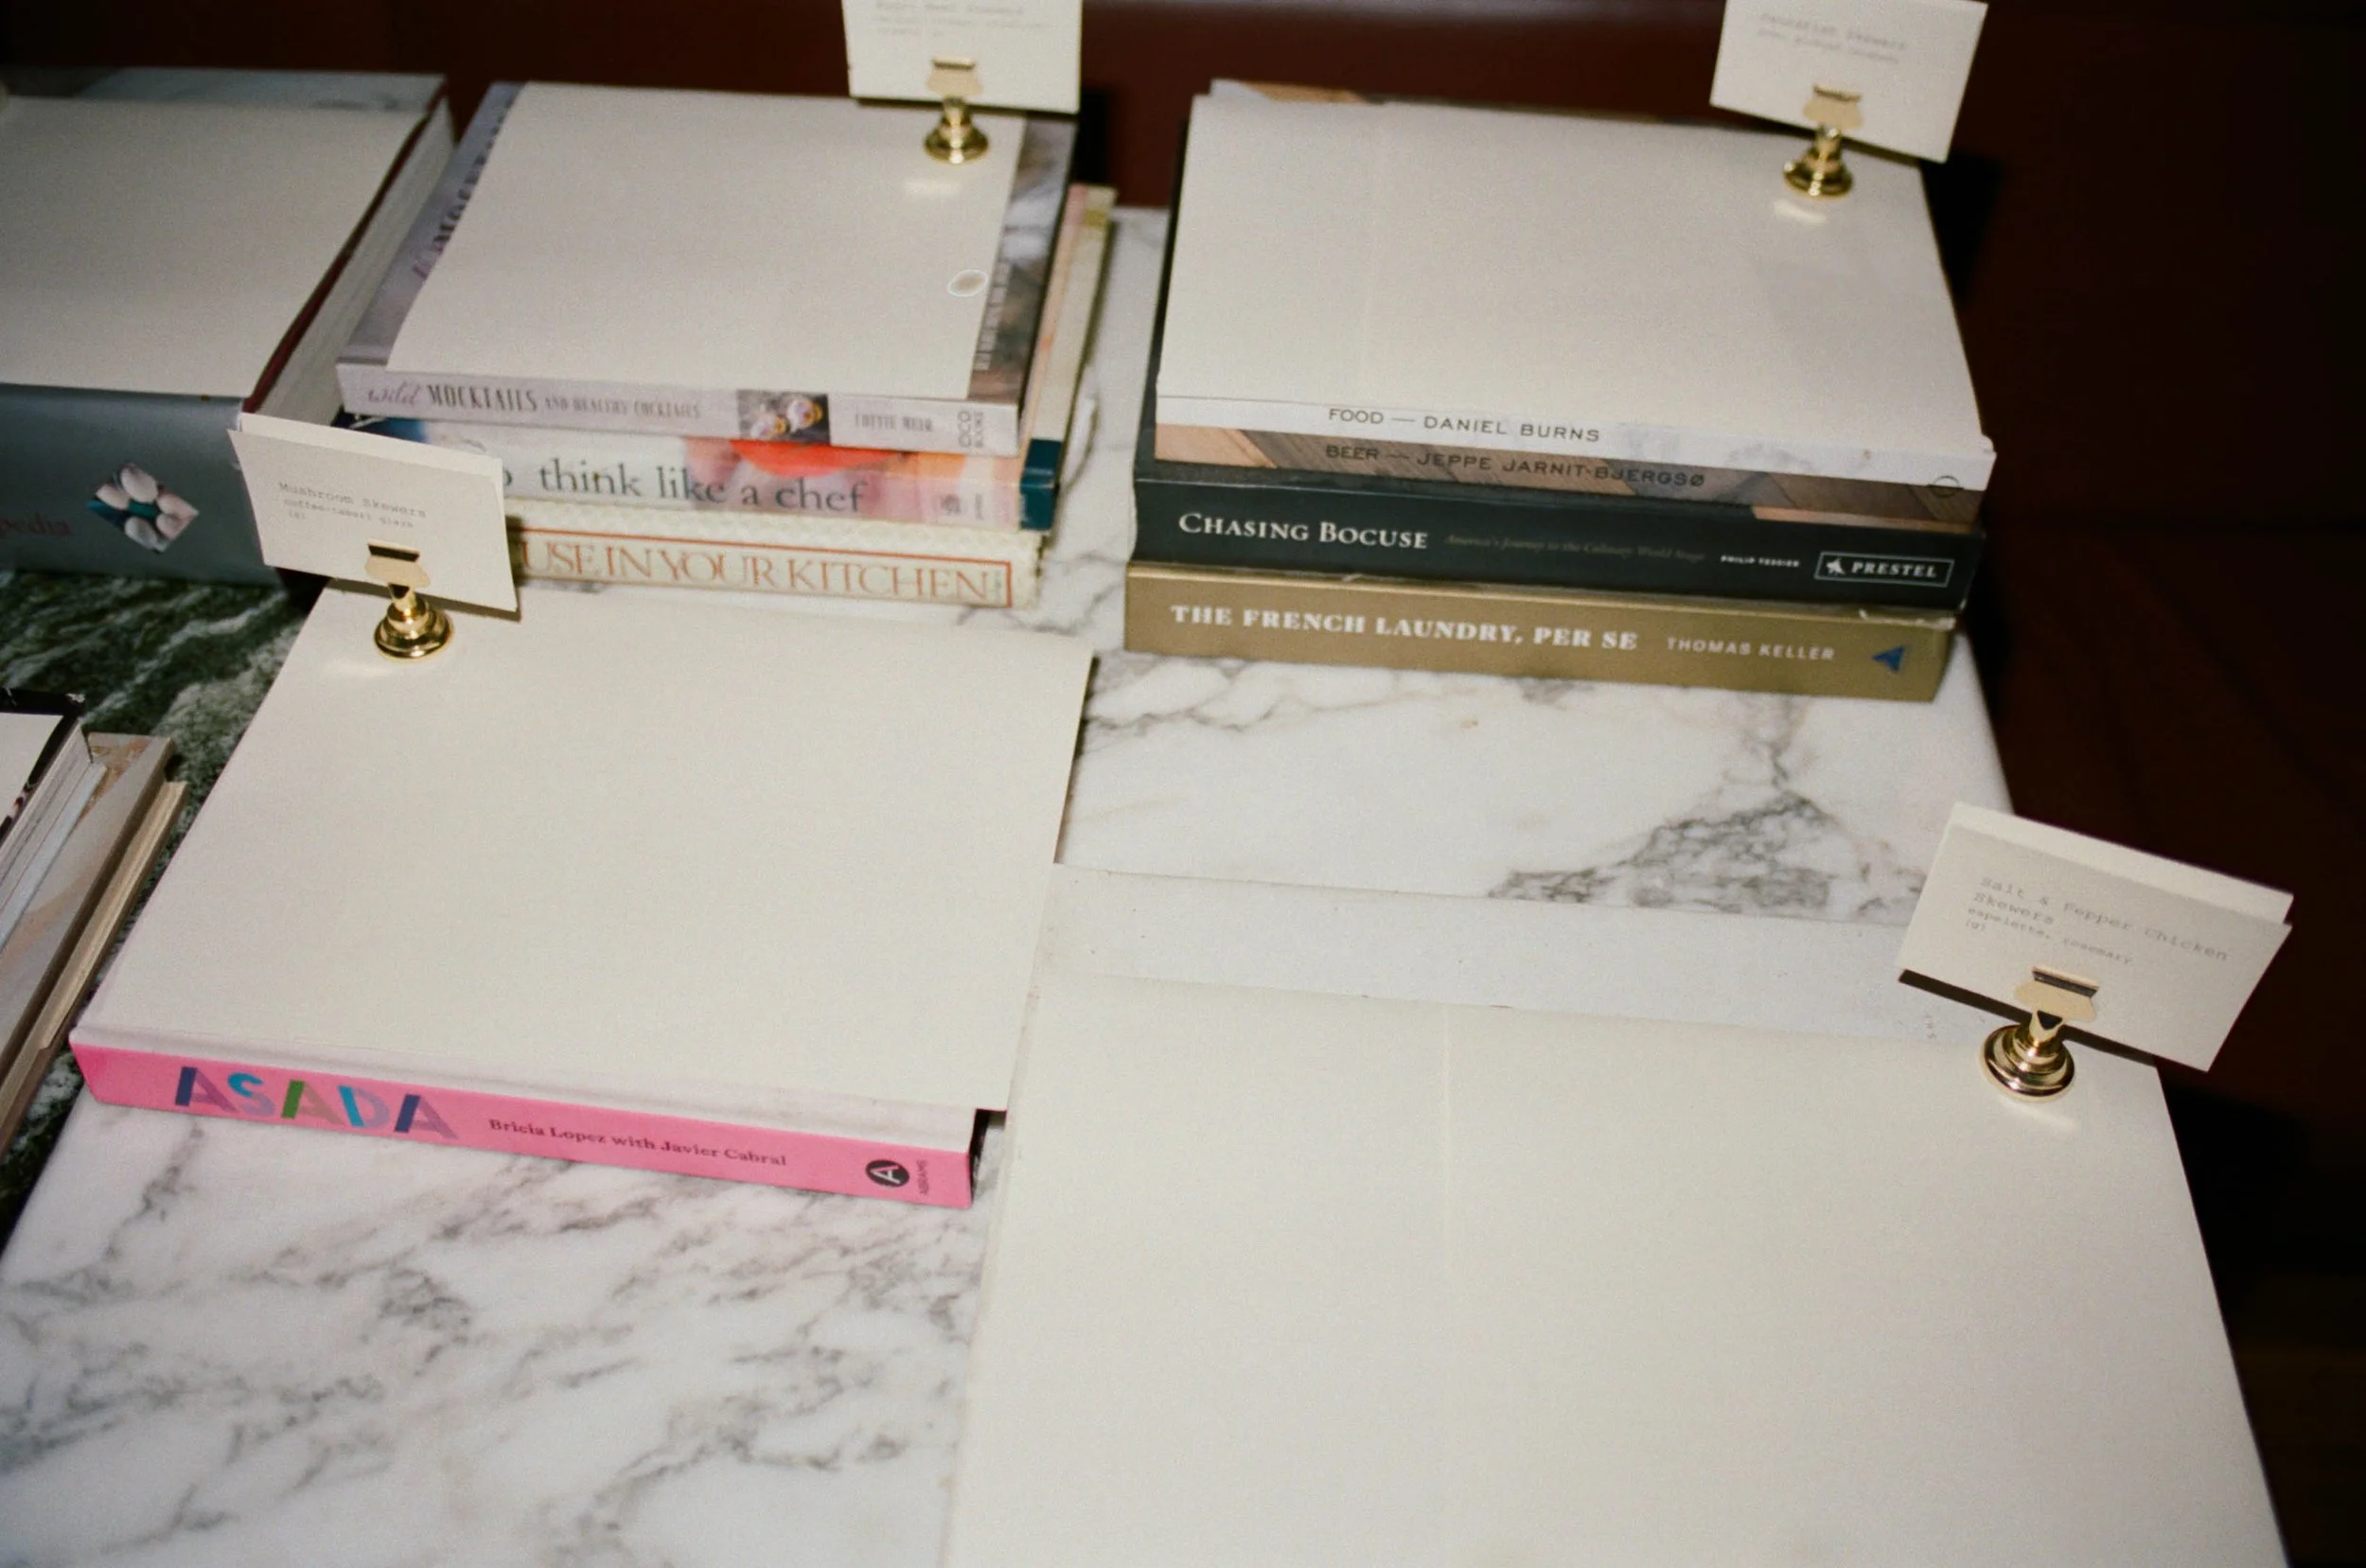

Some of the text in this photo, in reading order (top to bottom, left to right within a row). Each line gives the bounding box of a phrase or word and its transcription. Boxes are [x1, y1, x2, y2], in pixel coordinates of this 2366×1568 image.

[426, 384, 539, 412] MOCKTAILS
[1328, 407, 1385, 425] FOOD
[1423, 415, 1508, 435] DANIEL
[1519, 423, 1600, 443] BURNS
[1325, 444, 1380, 461] BEER
[1417, 451, 1492, 471] JEPPE
[278, 481, 427, 519] Mushroom Skewers
[539, 457, 643, 498] think
[657, 466, 726, 504] like
[740, 483, 759, 506] a
[774, 478, 869, 513] chef
[521, 540, 990, 602] USE IN YOUR KITCHEN
[1850, 560, 1938, 579] PRESTEL
[1170, 604, 1638, 651] THE FRENCH LAUNDRY, PER SE
[1667, 636, 1835, 661] THOMAS KELLER
[1972, 891, 2056, 925] Skewers
[1980, 876, 2025, 900] Salt
[2062, 901, 2131, 931] Pepper
[2144, 926, 2229, 962] Chicken
[2062, 937, 2132, 965] rosemary
[174, 1066, 459, 1140] ASADA
[488, 1117, 788, 1167] Bricia Lopez with Javier Cabral
